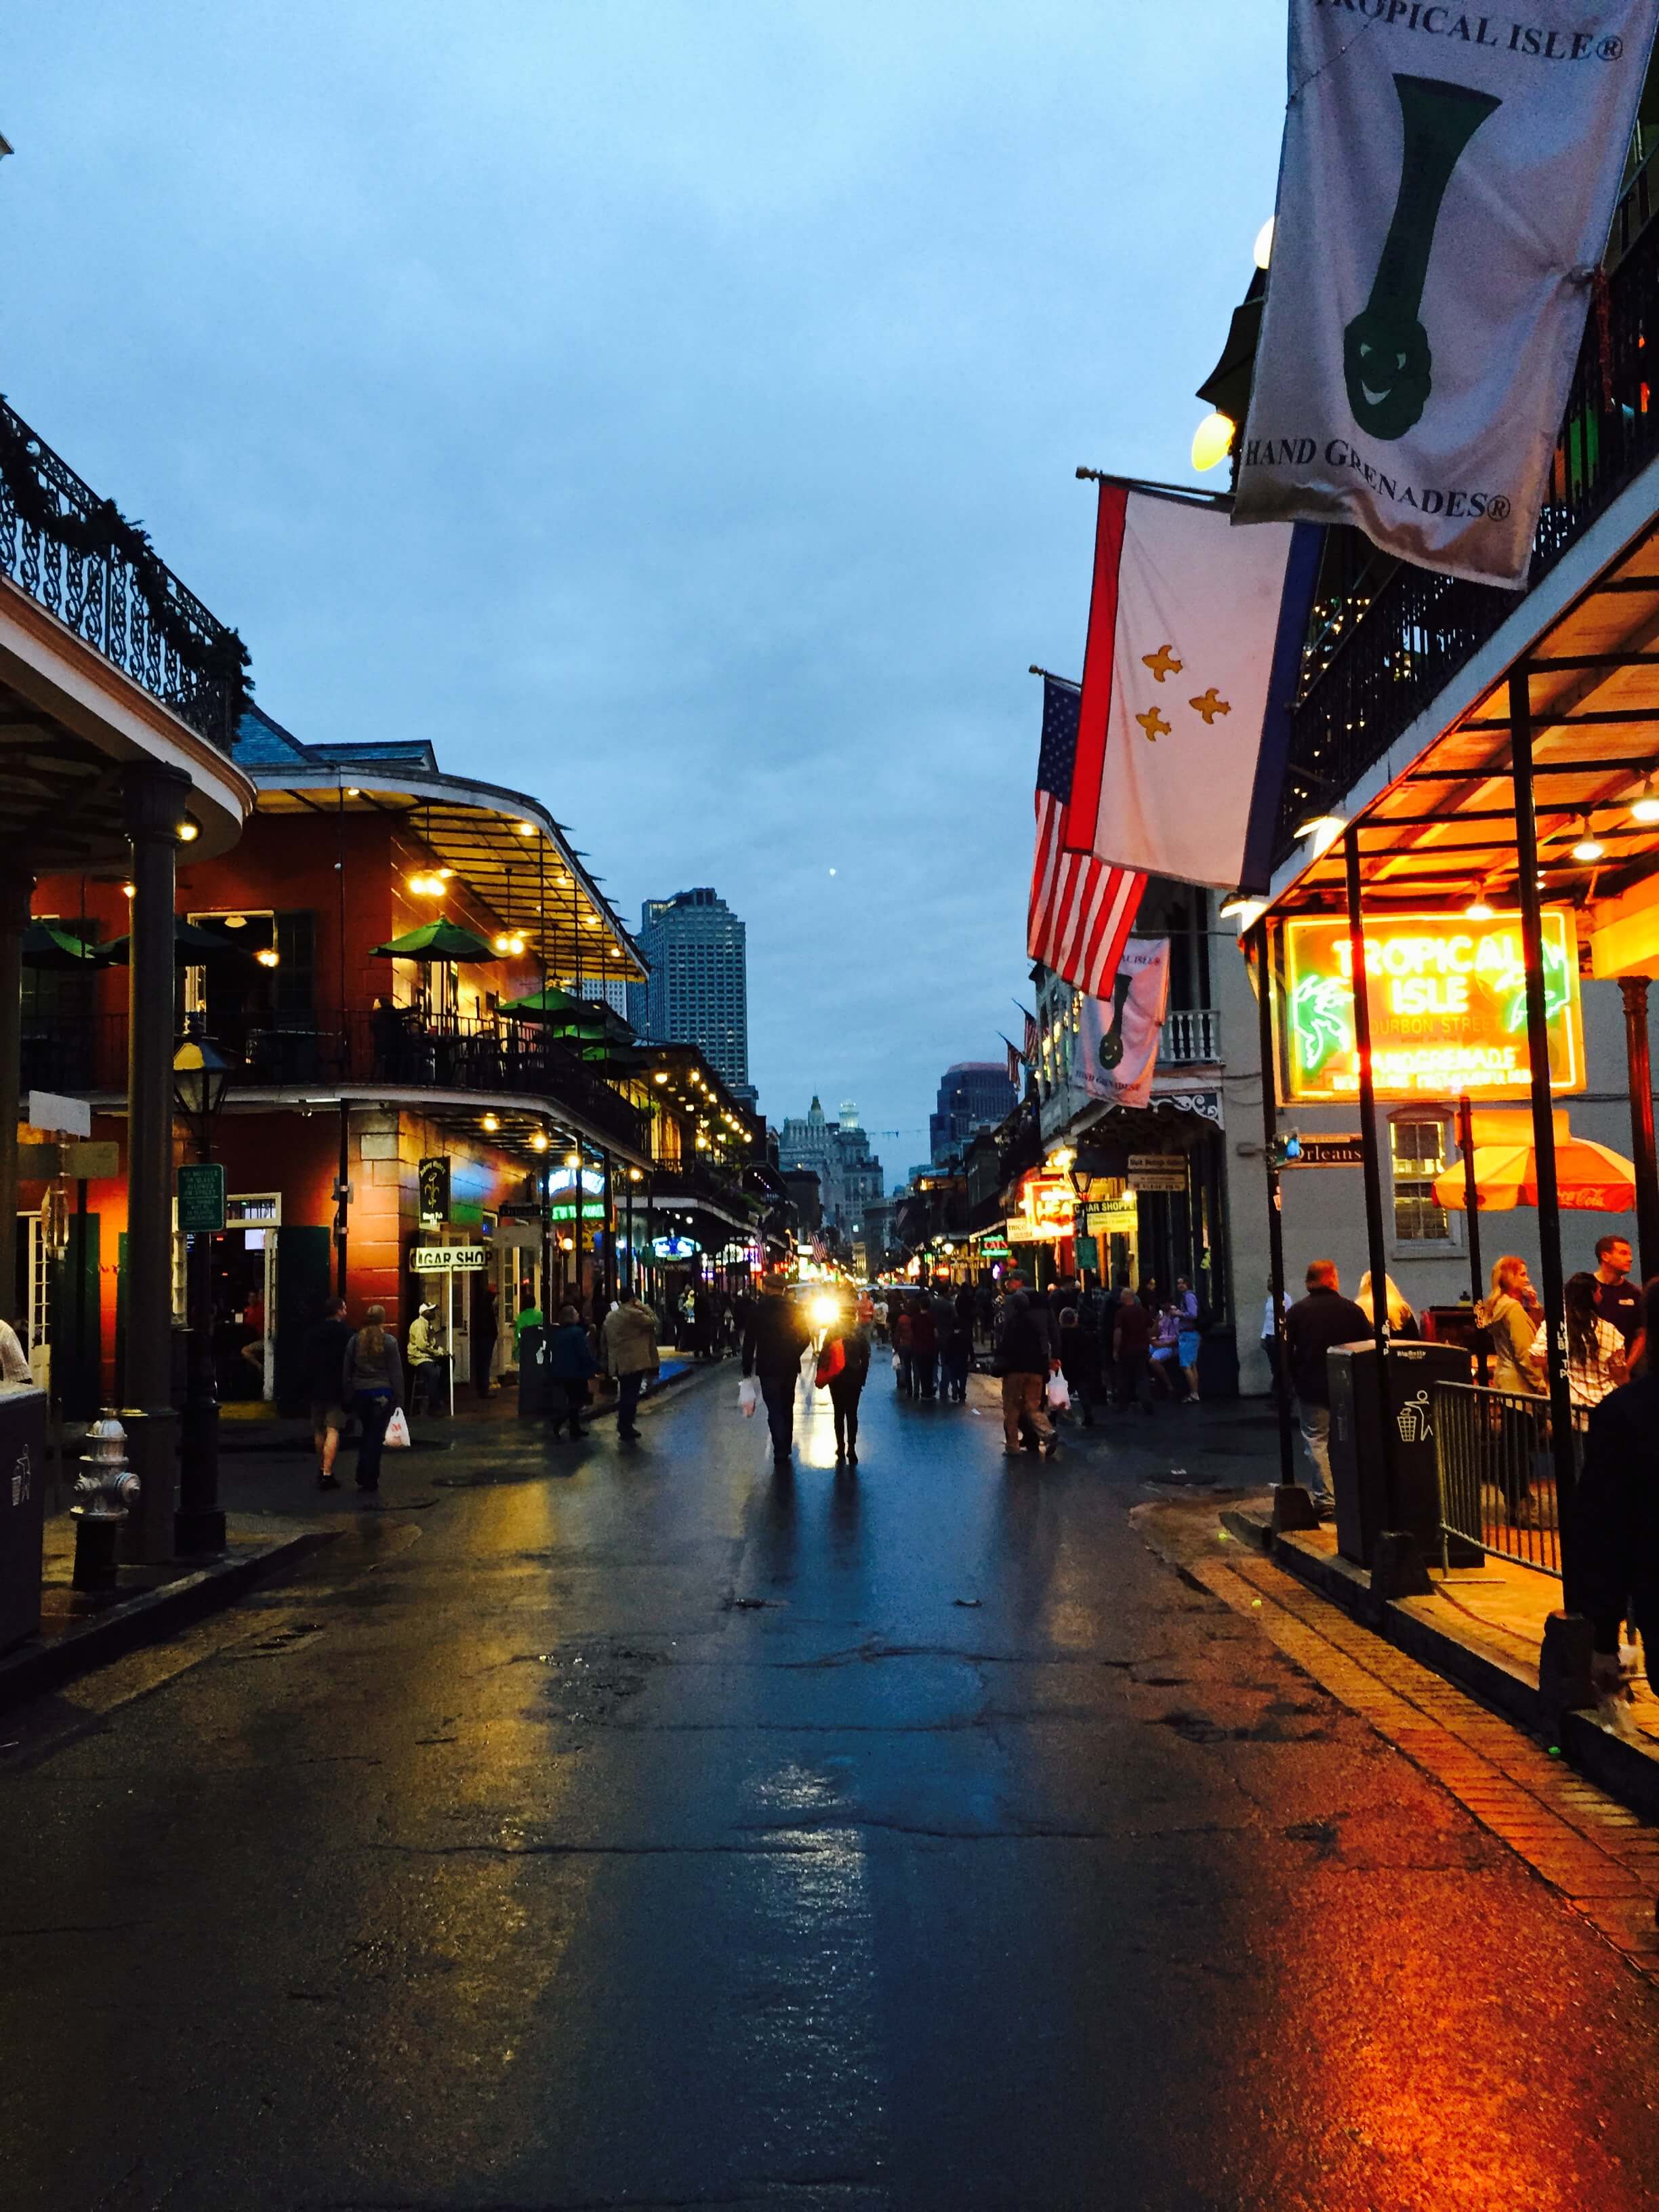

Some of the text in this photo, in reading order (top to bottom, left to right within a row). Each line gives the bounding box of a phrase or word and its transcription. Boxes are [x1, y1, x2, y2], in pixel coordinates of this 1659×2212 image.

[1316, 0, 1497, 45] OPICAL
[1246, 438, 1316, 466] HAND
[1332, 935, 1523, 977] TROPICAL
[1392, 976, 1469, 1015] ISLE
[1371, 1017, 1433, 1035] OURBON
[1074, 1203, 1100, 1214] CAR
[456, 1252, 493, 1266] SHOP
